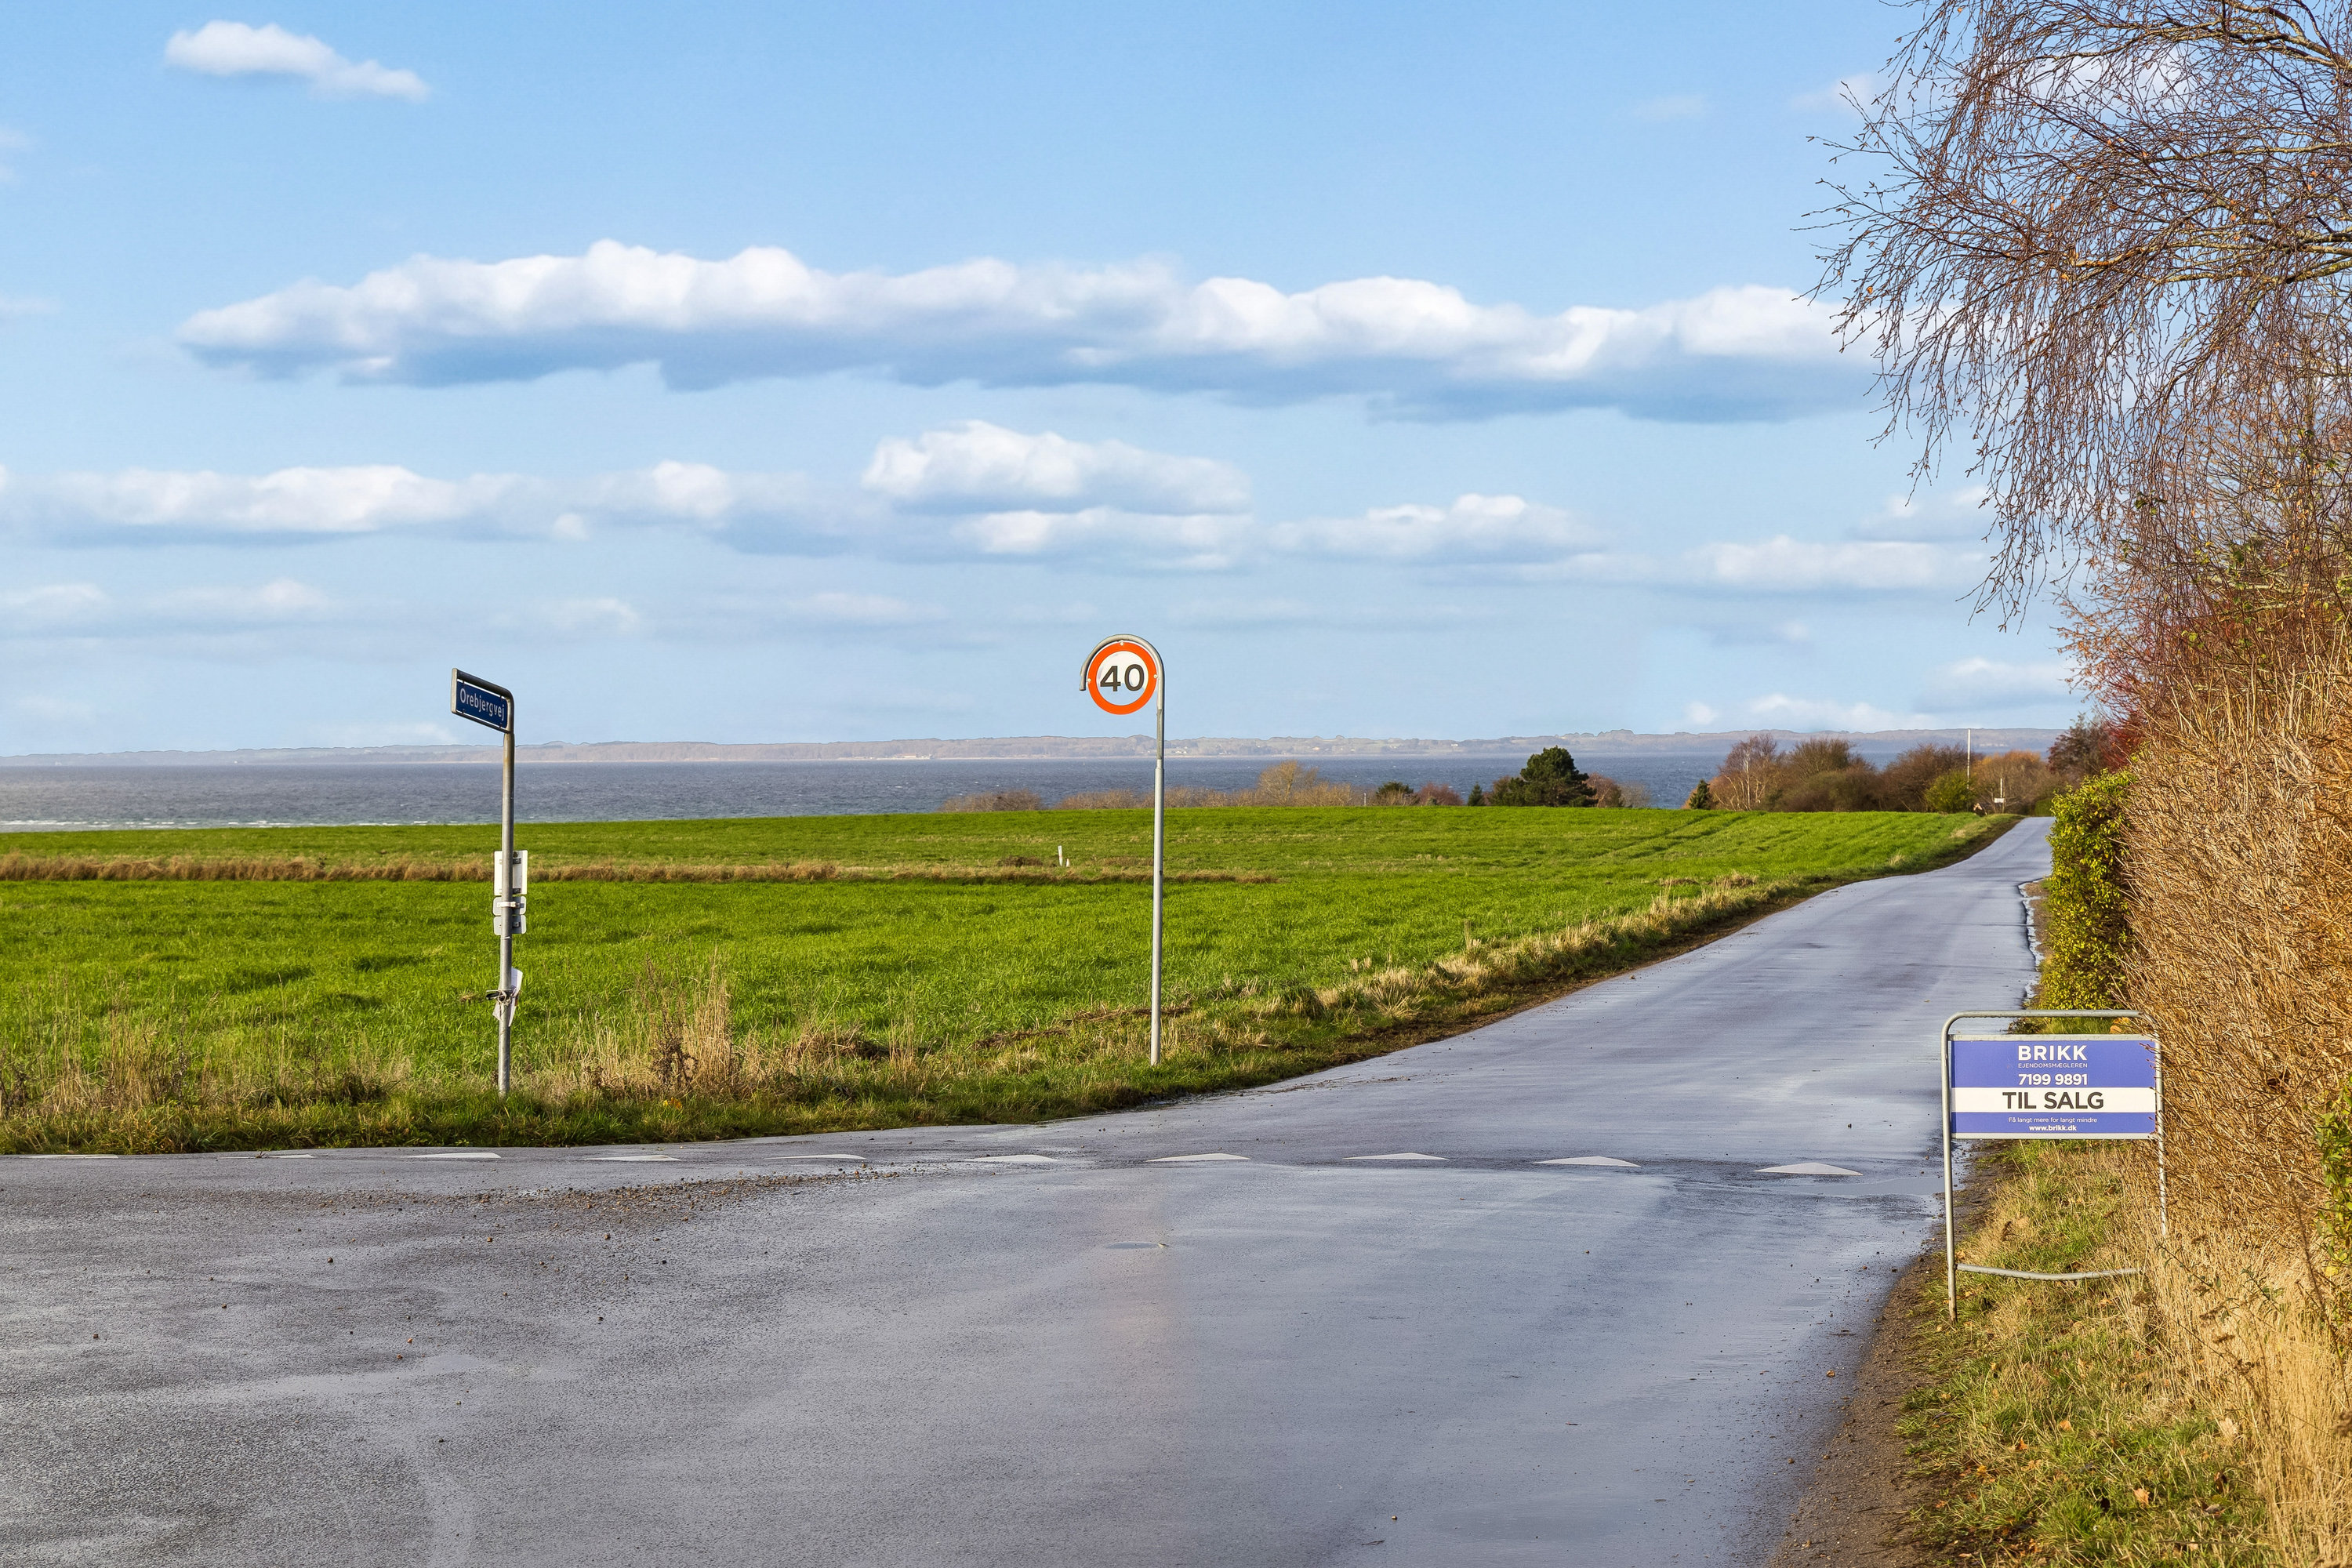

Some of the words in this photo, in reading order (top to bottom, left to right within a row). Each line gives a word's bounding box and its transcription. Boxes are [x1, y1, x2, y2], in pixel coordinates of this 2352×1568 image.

[1100, 664, 1145, 691] 40
[459, 688, 504, 721] Orebjergvej
[2018, 1045, 2088, 1061] BRIKK
[2018, 1073, 2051, 1086] 7199
[2055, 1073, 2088, 1086] 9891
[2002, 1092, 2037, 1109] TIL
[2044, 1091, 2104, 1109] SALG
